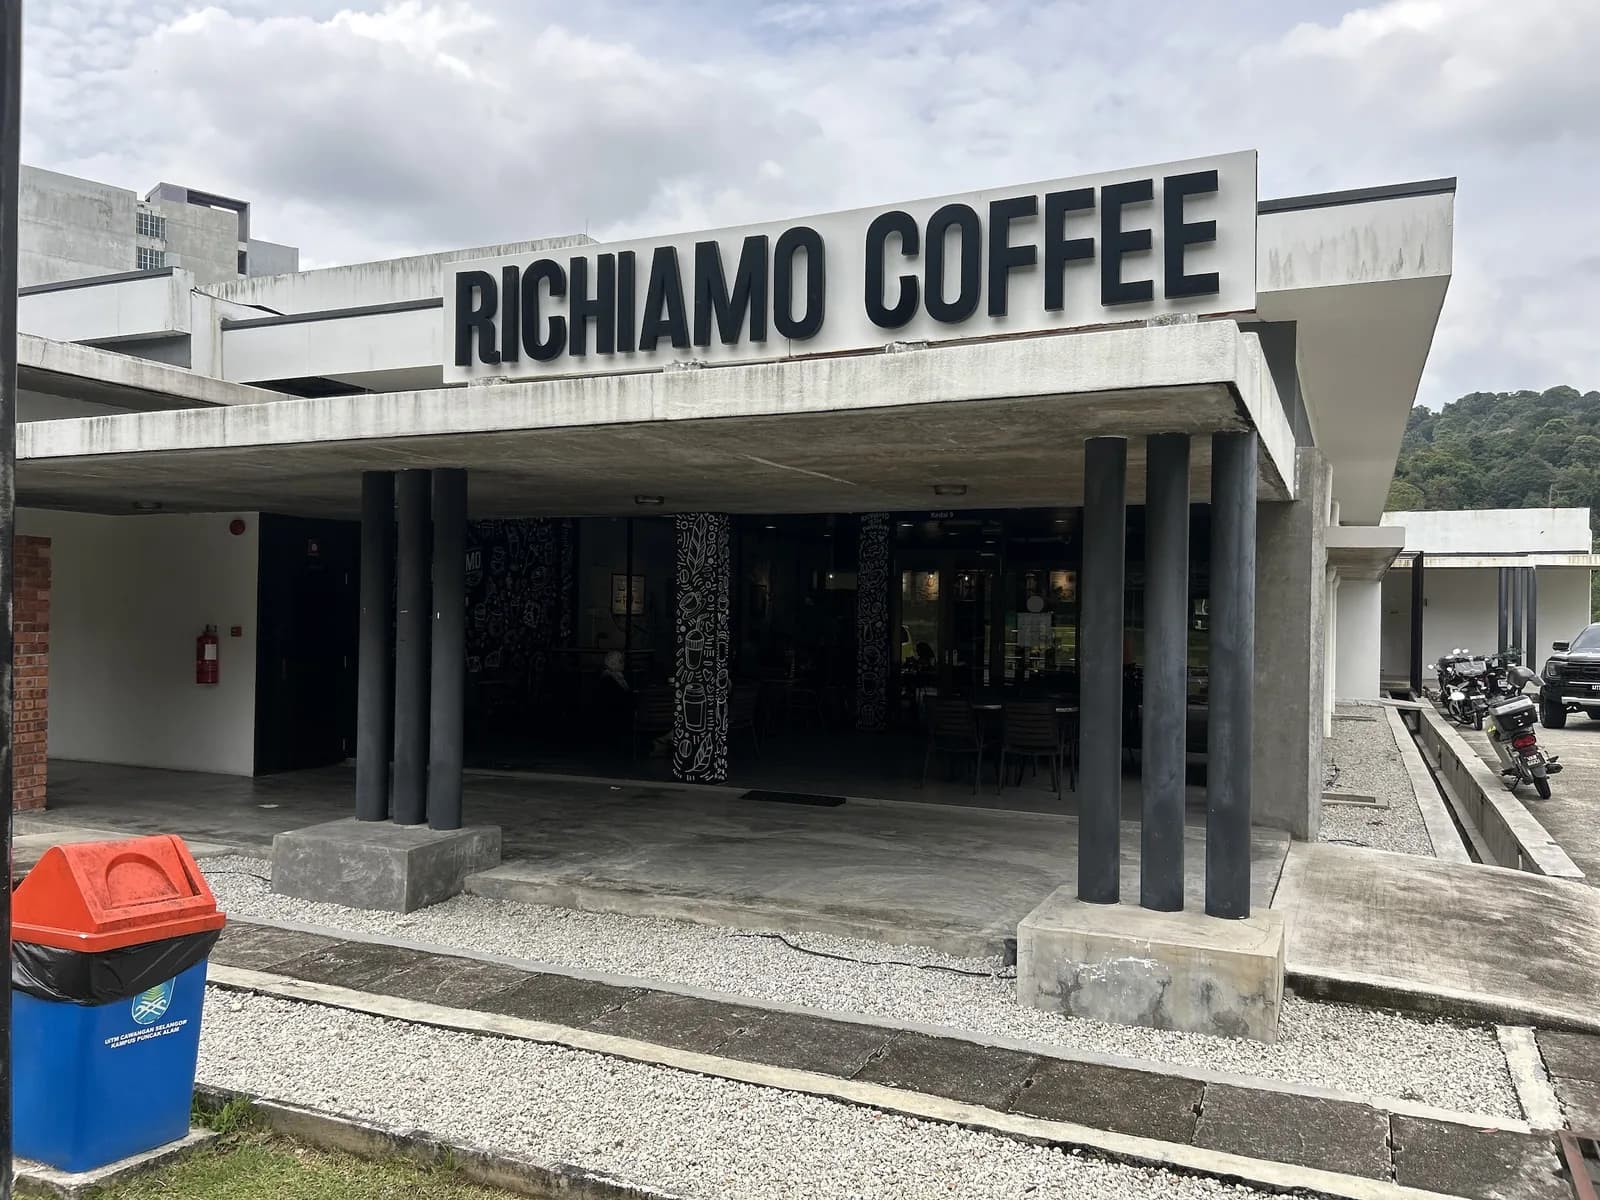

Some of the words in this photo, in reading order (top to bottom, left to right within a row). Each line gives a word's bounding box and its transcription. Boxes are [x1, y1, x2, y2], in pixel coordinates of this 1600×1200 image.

[455, 226, 825, 366] RICHIAMO
[864, 169, 1220, 329] COFFEE
[466, 551, 481, 571] MO
[110, 1038, 136, 1049] KAMPUS
[137, 1031, 162, 1042] PUNCAK
[162, 1027, 180, 1035] ALAM
[120, 1027, 154, 1040] CAWANGAN
[155, 1019, 188, 1031] SELANGOR
